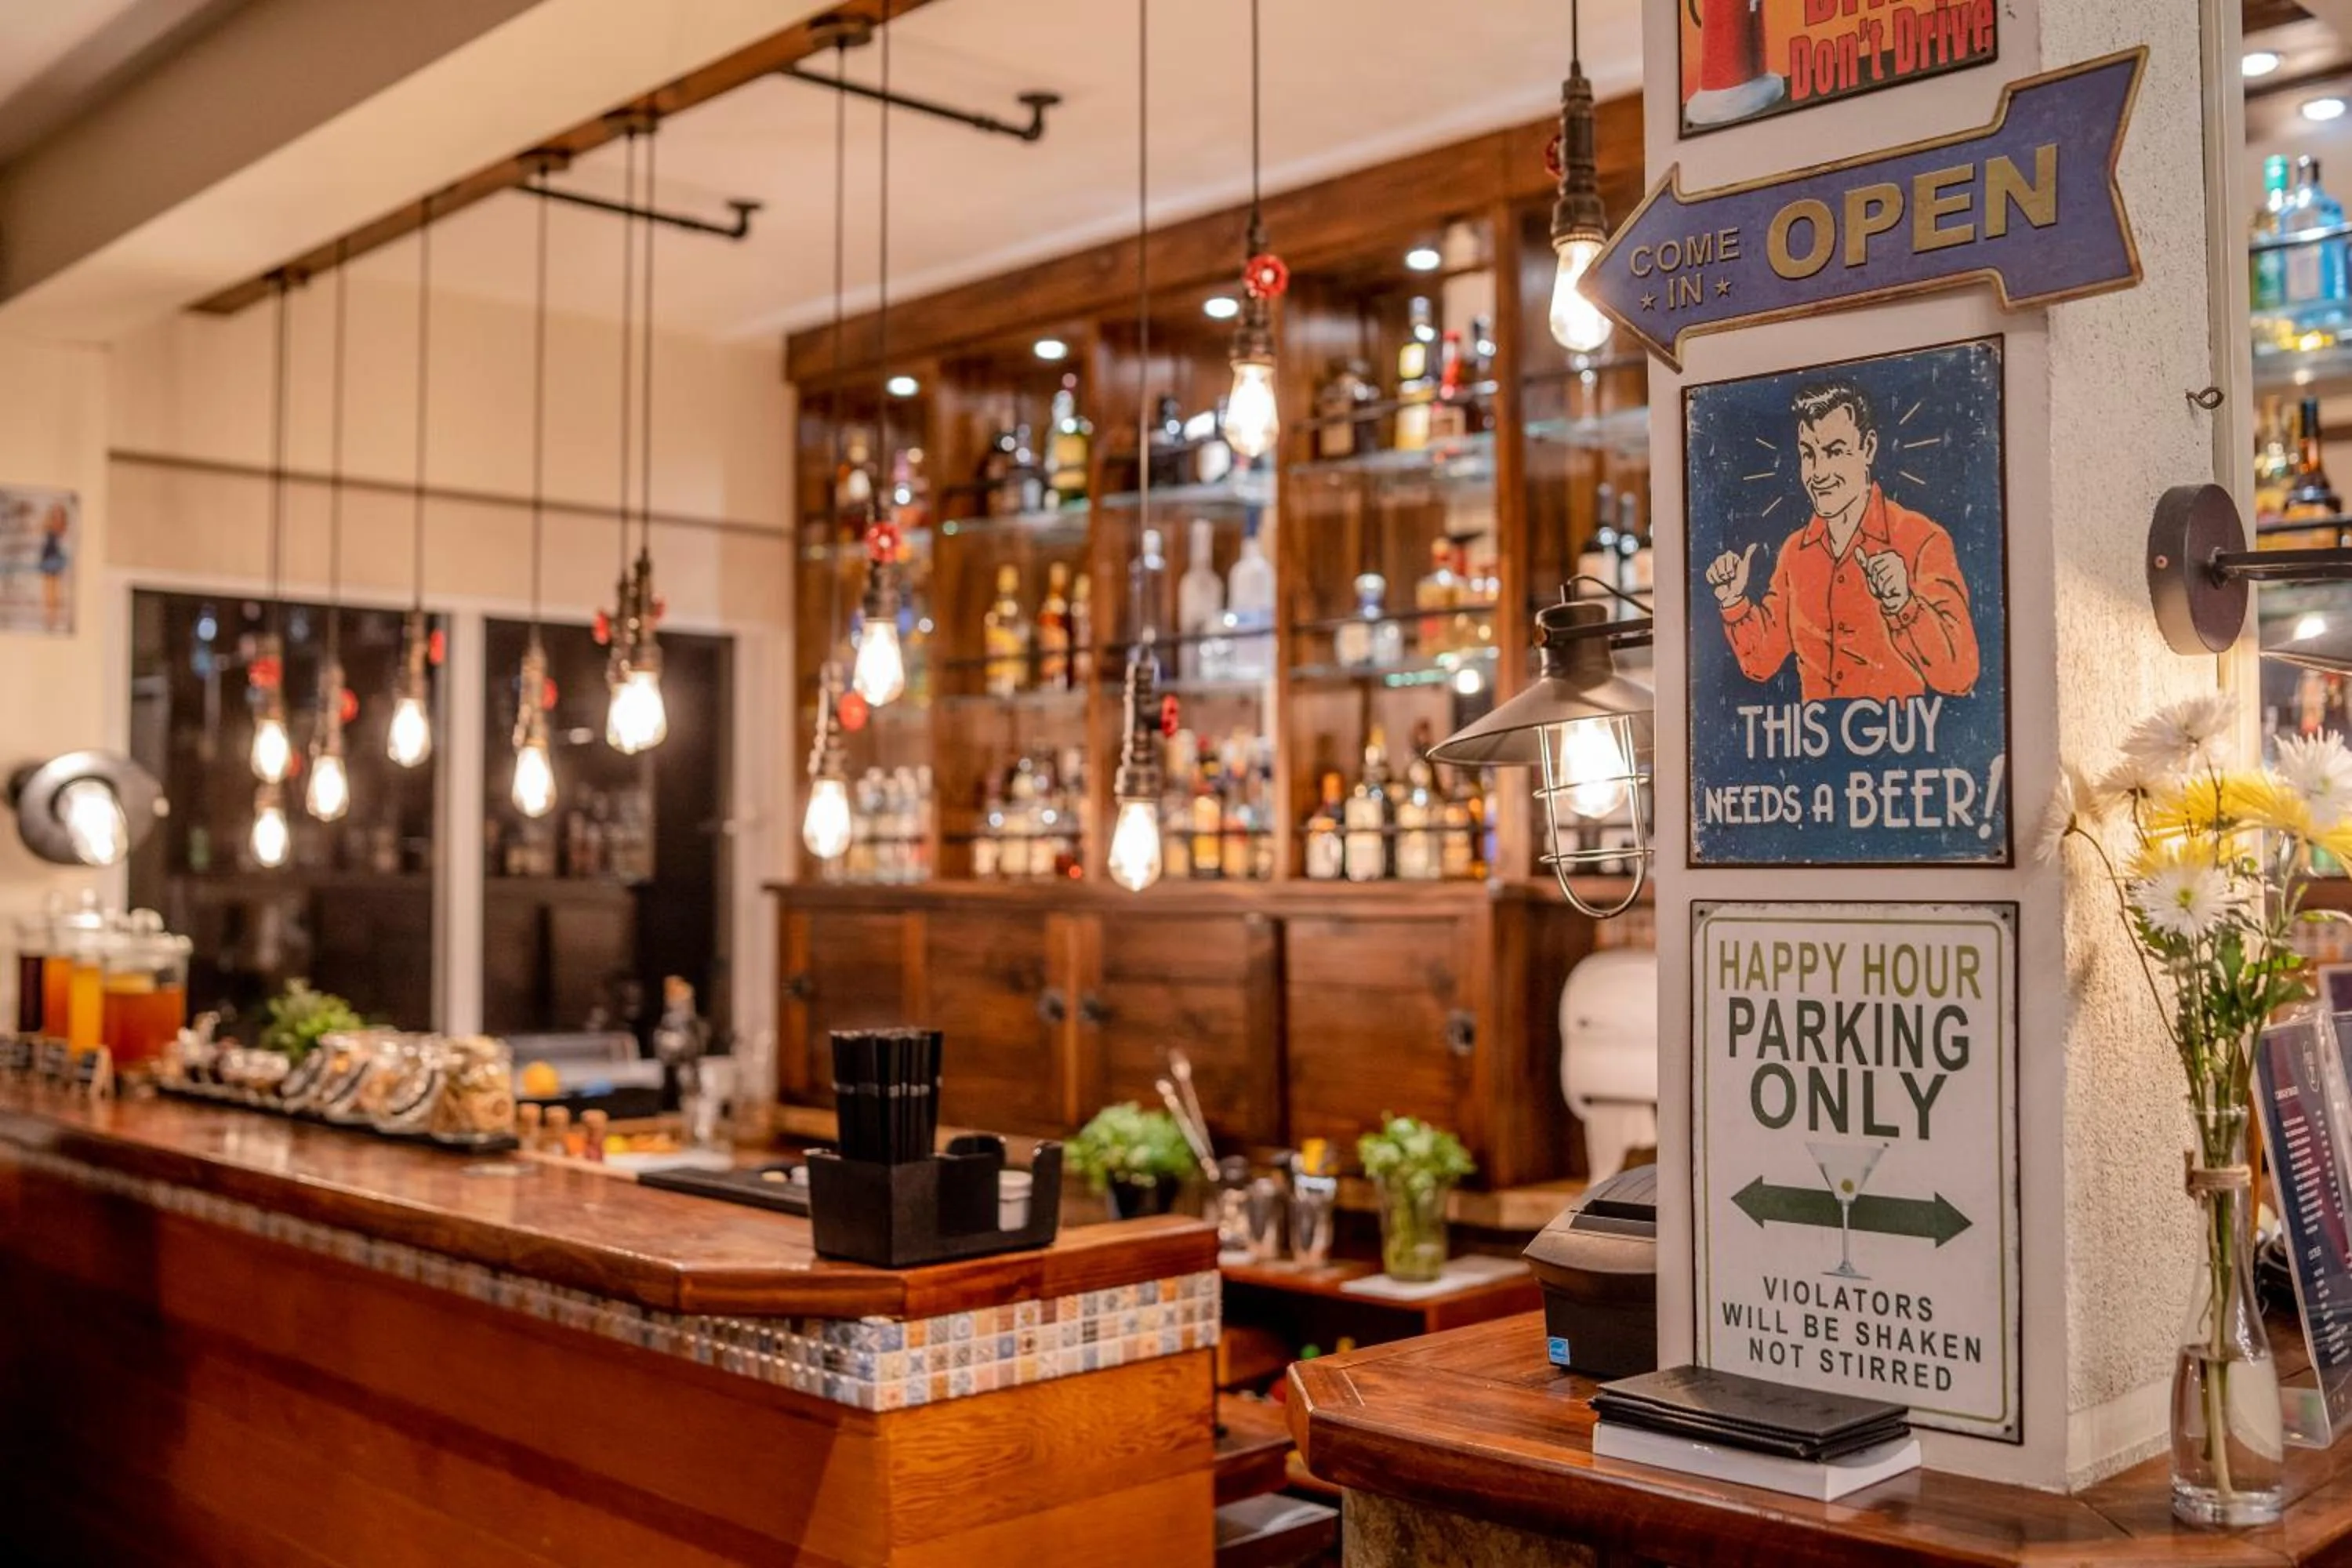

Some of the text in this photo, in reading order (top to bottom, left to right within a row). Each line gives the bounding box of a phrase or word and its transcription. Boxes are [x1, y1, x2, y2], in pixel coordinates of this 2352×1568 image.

[1790, 0, 1993, 100] Don't Drive
[1630, 143, 2059, 280] COME OPEN
[1668, 273, 1703, 309] IN
[1737, 695, 1944, 758] THIS GUY
[1705, 754, 2006, 840] NEEDS A BEER!
[1719, 940, 1982, 1000] HAPPY HOUR
[1729, 996, 1970, 1072] PARKING
[1750, 1062, 1947, 1140] ONLY
[1762, 1276, 1933, 1322] VIOLATORS
[1722, 1301, 1981, 1363] WILL BE SHAKEN
[1749, 1338, 1952, 1392] NOT STIRRED
